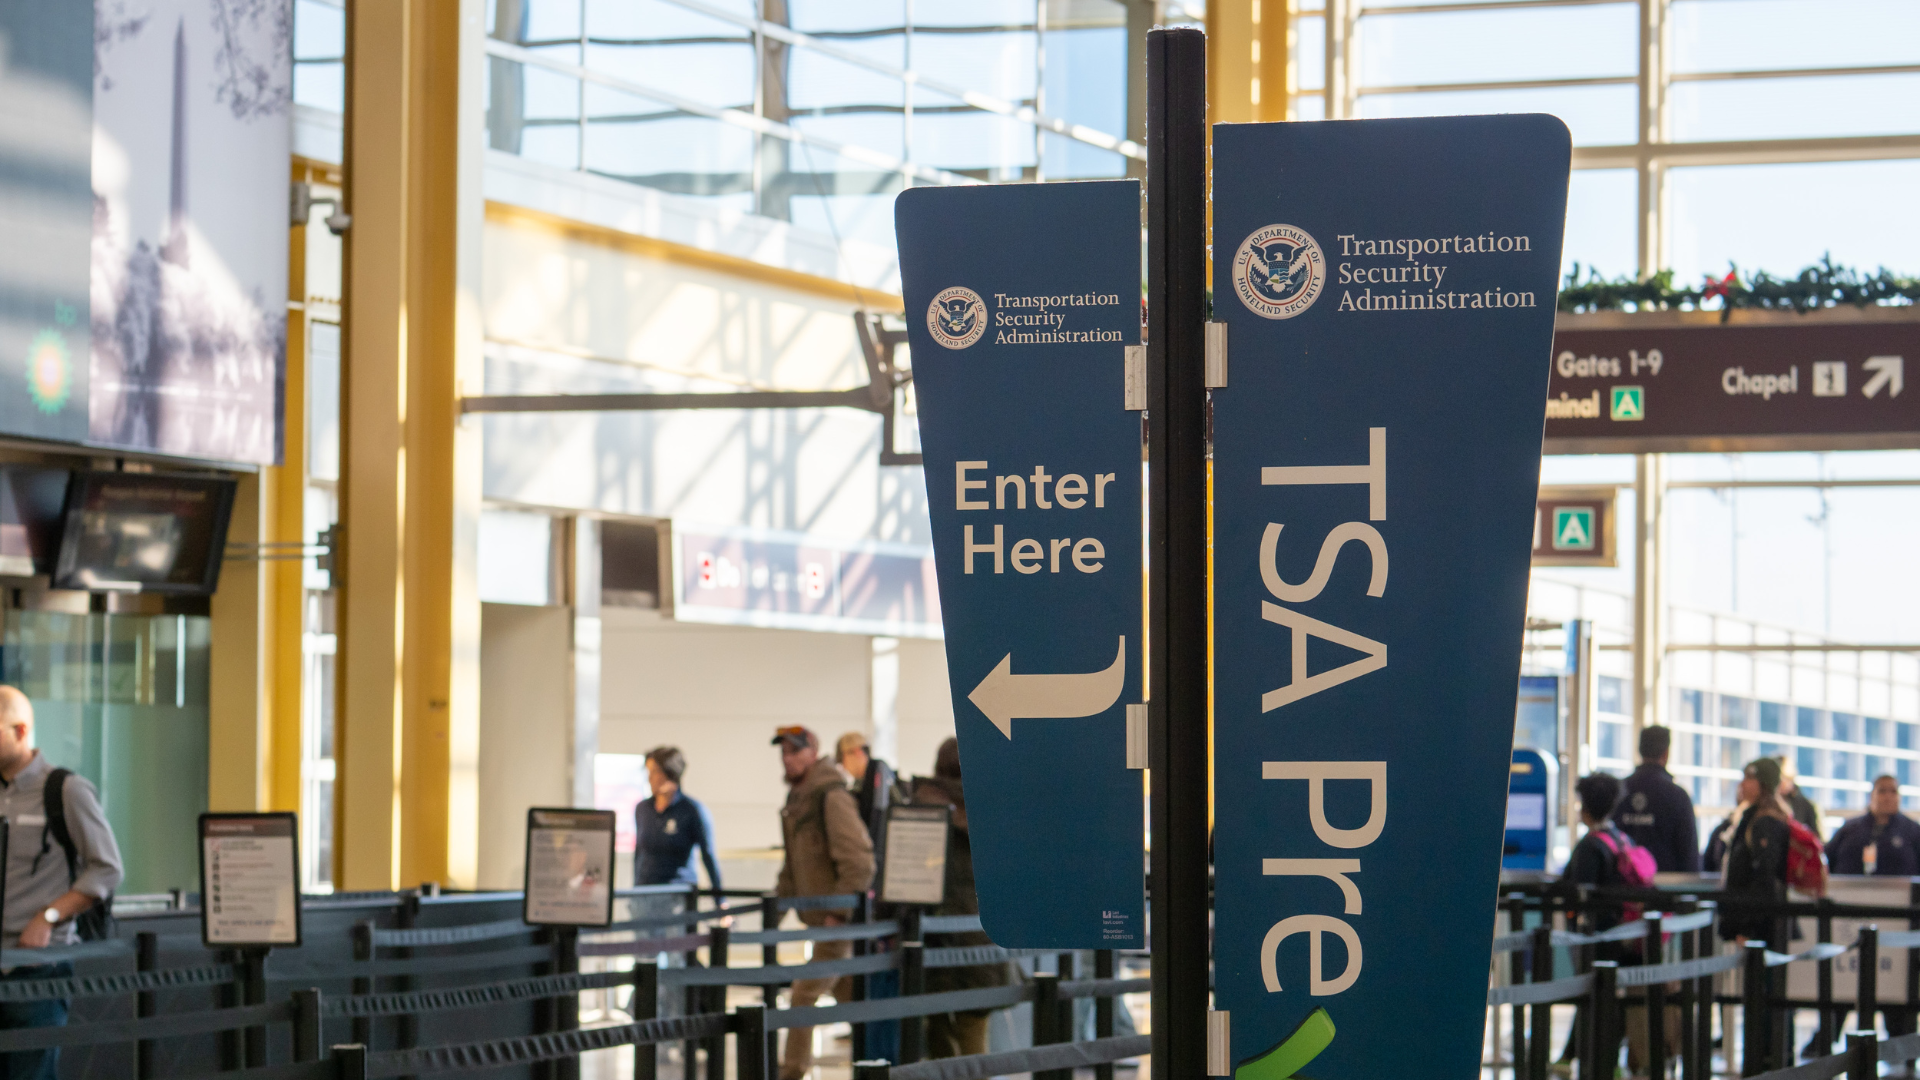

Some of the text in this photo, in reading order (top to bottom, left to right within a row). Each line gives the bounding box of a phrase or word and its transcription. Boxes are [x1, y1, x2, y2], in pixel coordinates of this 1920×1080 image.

[1251, 229, 1314, 251] DEPARTMENT
[1310, 251, 1321, 264] OF
[1338, 232, 1532, 261] Transportation
[1338, 262, 1447, 288] Security
[995, 292, 1120, 312] Transportation
[1237, 274, 1320, 315] HOMELAND SECURITY
[1337, 287, 1536, 312] Administration
[995, 311, 1065, 330] Security
[995, 327, 1124, 344] Administration
[1557, 348, 1664, 378] Gates 1-9
[1722, 365, 1798, 400] Chapel
[1546, 389, 1642, 419] minal A
[955, 461, 1116, 510] Enter
[1558, 512, 1590, 547] A
[963, 524, 1106, 575] Here
[1259, 427, 1389, 997] TSA Pre
